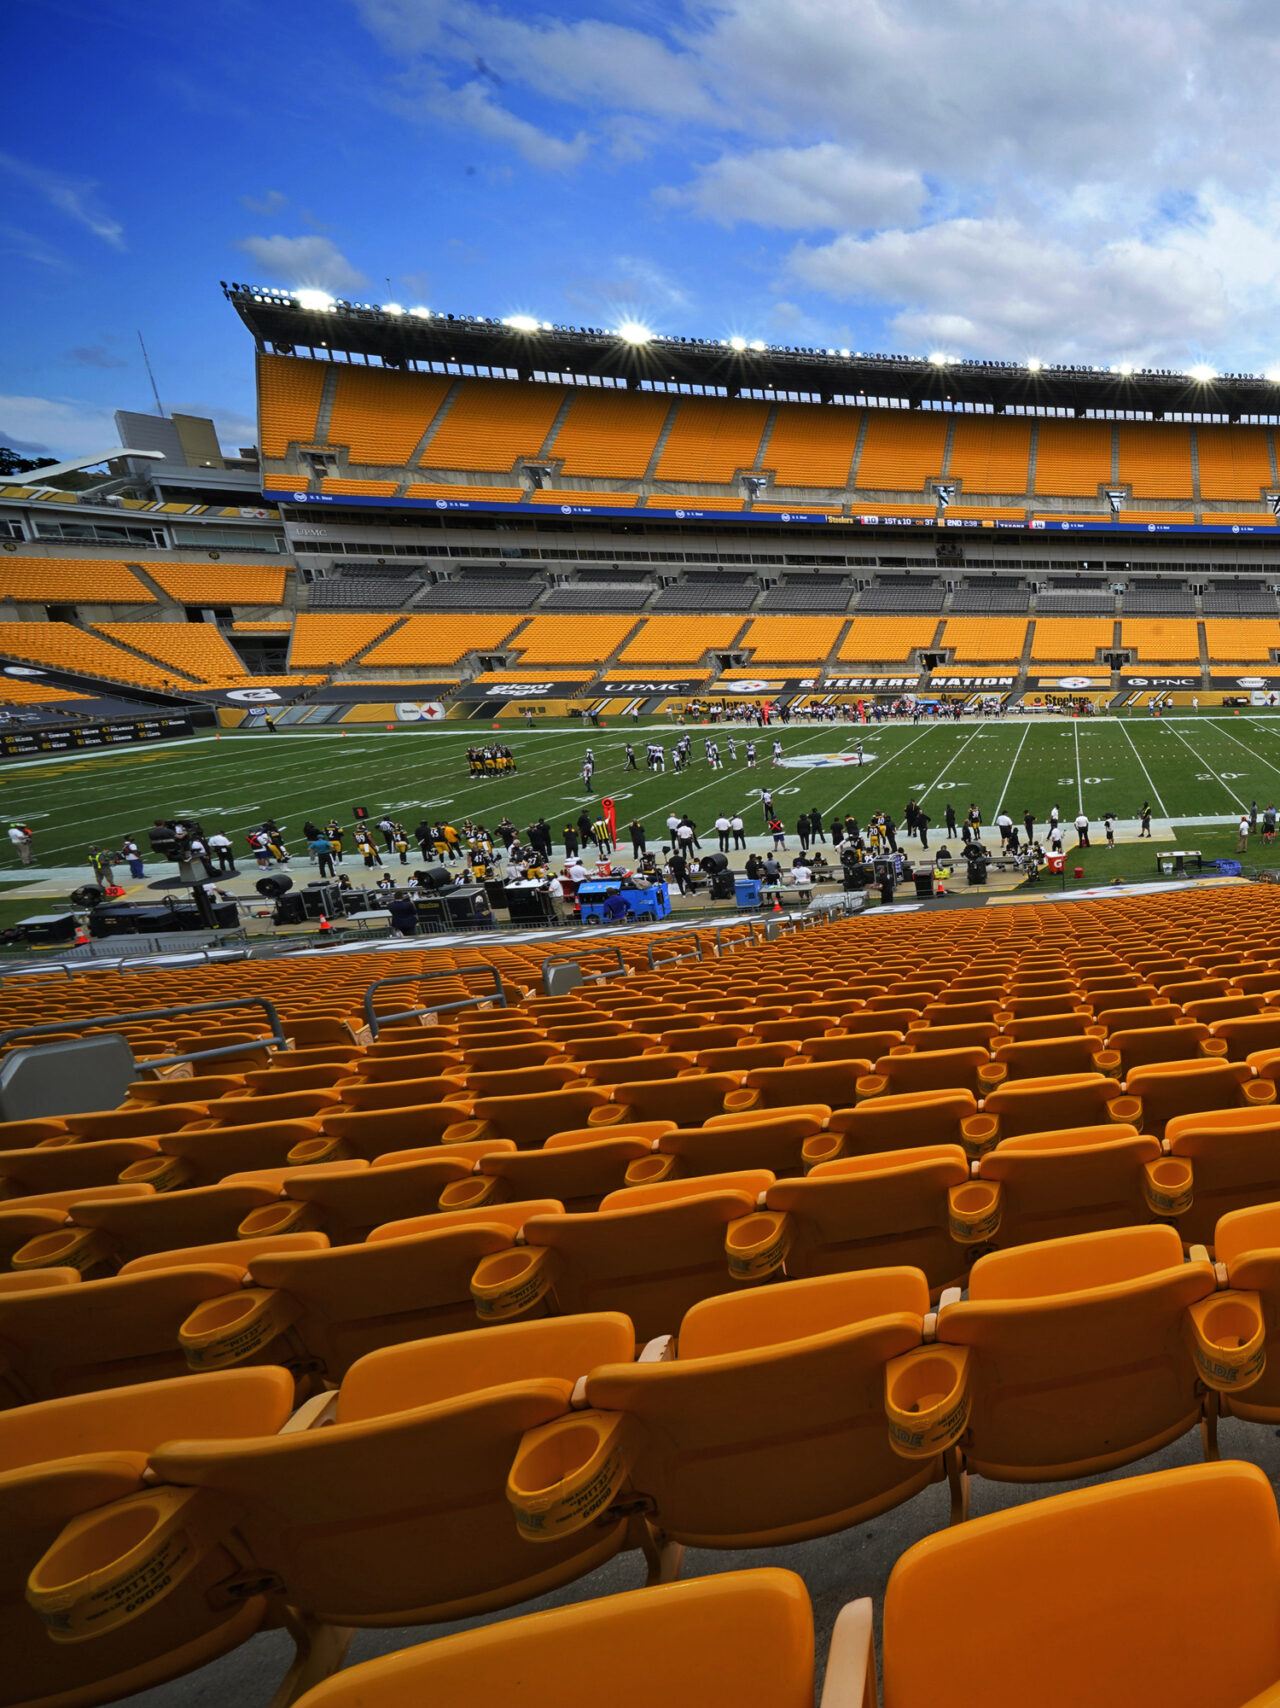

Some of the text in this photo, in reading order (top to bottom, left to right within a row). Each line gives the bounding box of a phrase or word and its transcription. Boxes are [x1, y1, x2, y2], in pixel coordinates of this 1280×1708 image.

[828, 516, 854, 524] Steelers
[884, 517, 897, 525] 1ST
[947, 519, 962, 527] 2ND
[296, 528, 328, 537] UPMC
[930, 677, 1014, 687] NATION
[1152, 678, 1195, 686] PNC
[485, 687, 549, 697] eagle
[491, 682, 554, 693] giant
[605, 682, 690, 693] UPMC
[1045, 693, 1090, 706] Steelers
[1057, 777, 1100, 785] 30
[1195, 772, 1239, 781] 20
[328, 830, 334, 838] 2
[1053, 859, 1062, 868] G
